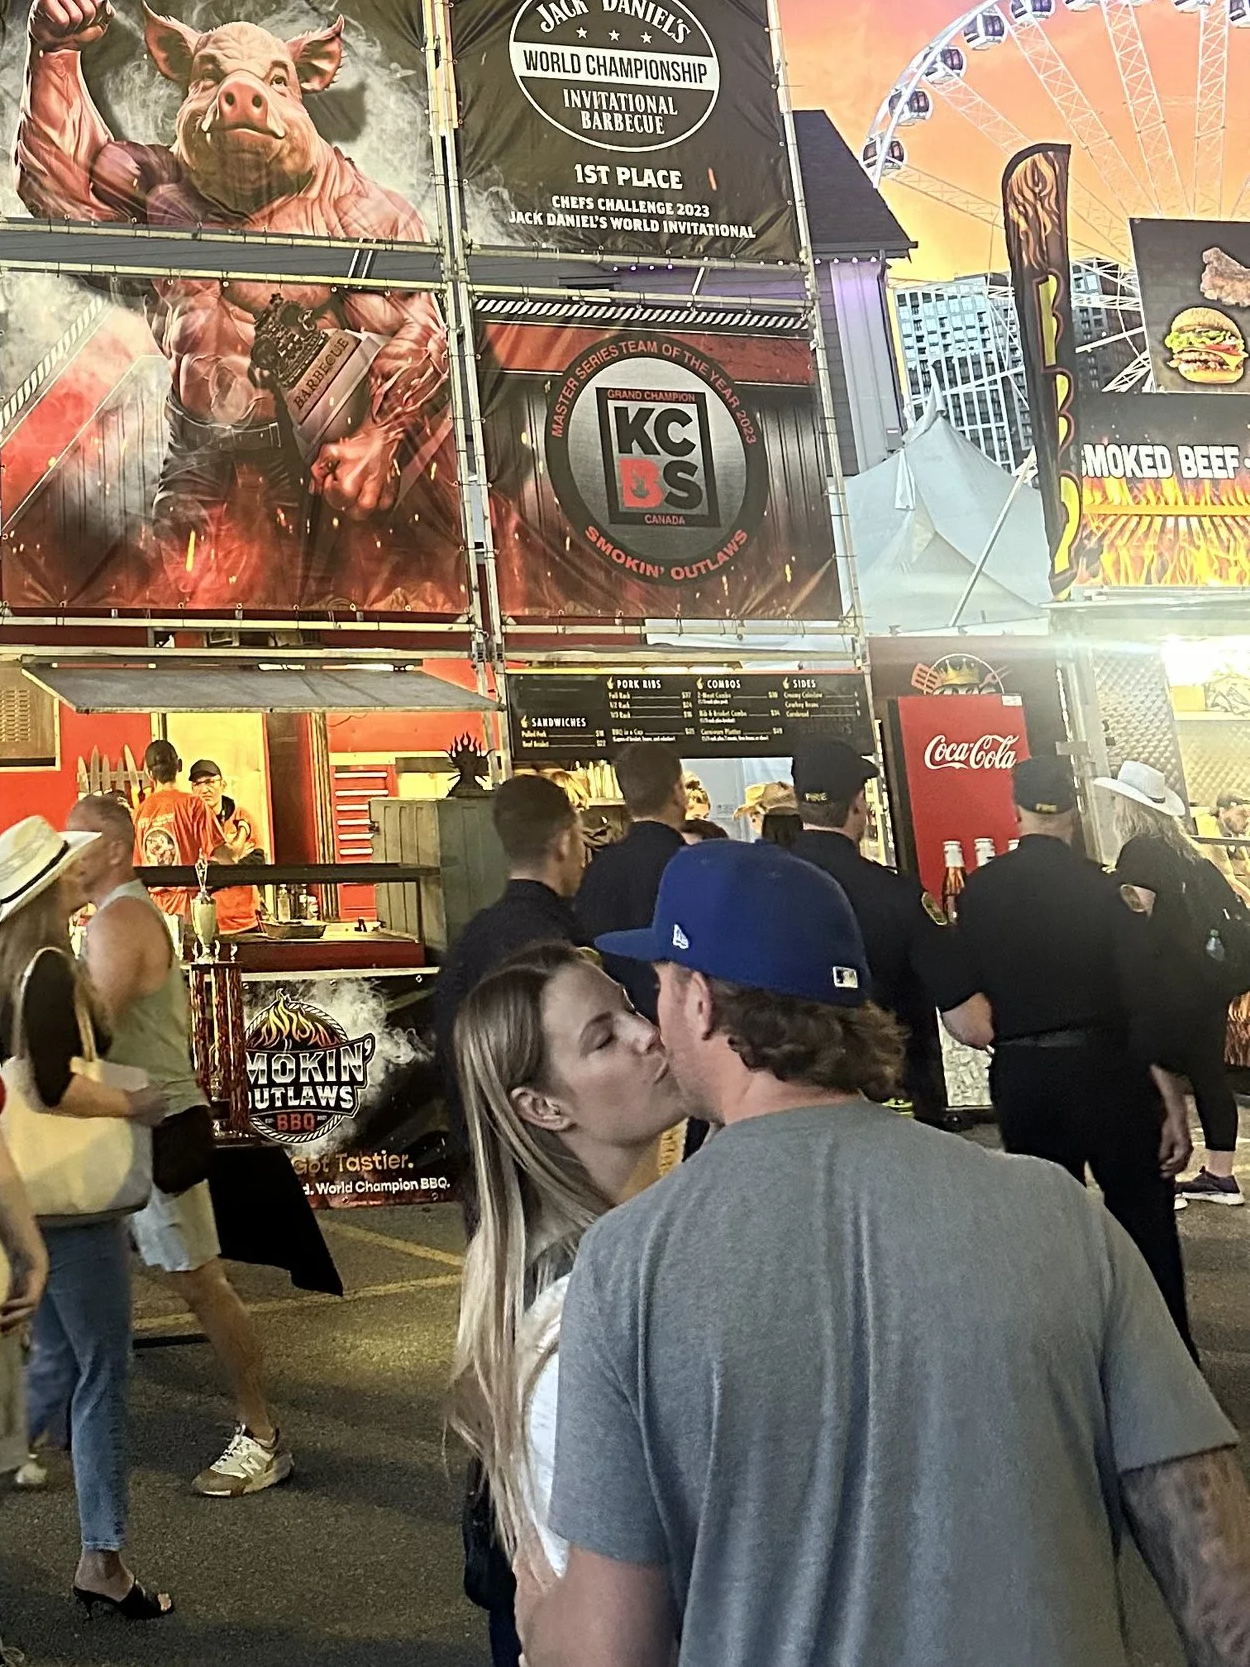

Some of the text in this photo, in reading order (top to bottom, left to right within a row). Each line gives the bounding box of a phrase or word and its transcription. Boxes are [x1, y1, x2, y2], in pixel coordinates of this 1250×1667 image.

[523, 49, 708, 84] WORLD CHAMPIONSHIP
[563, 89, 678, 116] INVITATIONAL
[580, 110, 665, 135] BARBECUE
[574, 163, 683, 190] 1ST PLACE
[551, 195, 710, 218] CHEFS CHALLENGE 2023
[506, 208, 757, 239] JACK DANIEL'S WORLD INVITATIONAL
[293, 338, 349, 410] BARBECUE
[551, 340, 757, 444] MASTER SERIES TEAM OF THE YEAR 2023
[607, 389, 695, 403] GRAND CHAMPION
[1177, 445, 1240, 479] BEEF
[644, 514, 686, 526] CANADA
[585, 525, 748, 580] SMOKIN' OUTLAWS
[616, 679, 662, 689] PORK RIBS
[707, 679, 741, 689] COMBOS
[792, 679, 816, 688] SIDES
[531, 717, 587, 727] SANDWICHES
[924, 734, 1019, 770] Coca-Cola
[246, 1038, 371, 1085] MOKIN'
[249, 1085, 354, 1110] UTLAWS
[276, 1113, 315, 1132] BBQ
[336, 1150, 414, 1173] Tastier.
[316, 1181, 353, 1195] World
[355, 1178, 419, 1197] Champion
[420, 1176, 451, 1190] BBQ.
